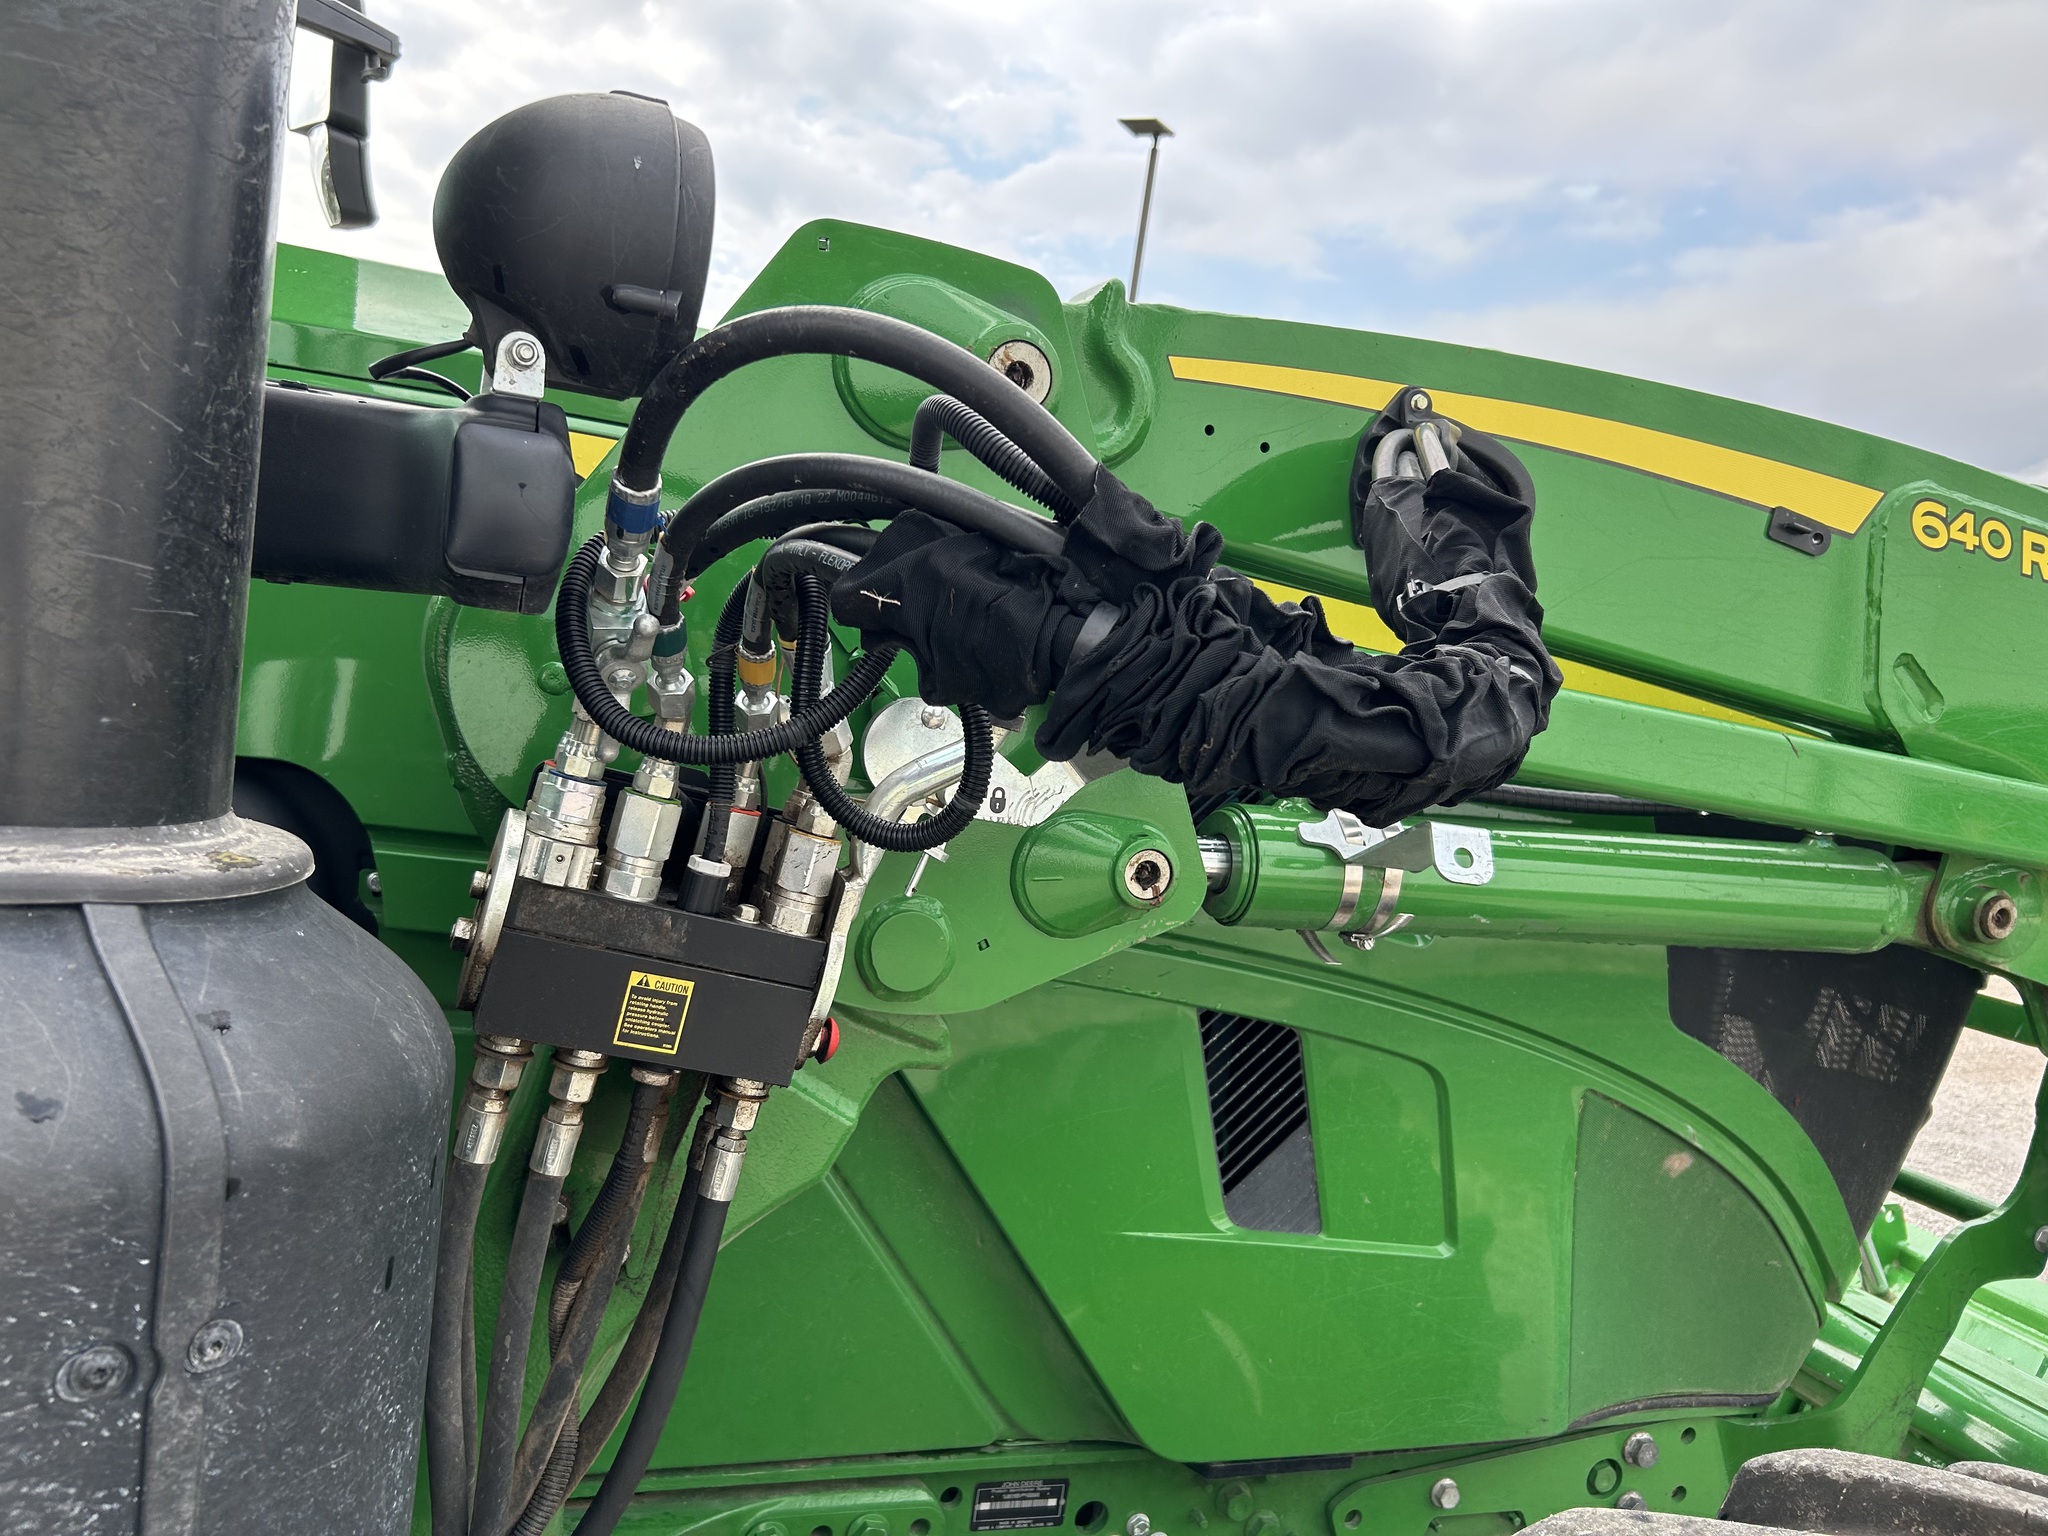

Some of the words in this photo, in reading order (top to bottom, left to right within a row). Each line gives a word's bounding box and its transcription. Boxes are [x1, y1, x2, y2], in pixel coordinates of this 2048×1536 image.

[818, 491, 831, 503] 22
[1911, 500, 2012, 559] 640
[2022, 529, 2048, 581] R
[654, 980, 689, 995] CAUTION
